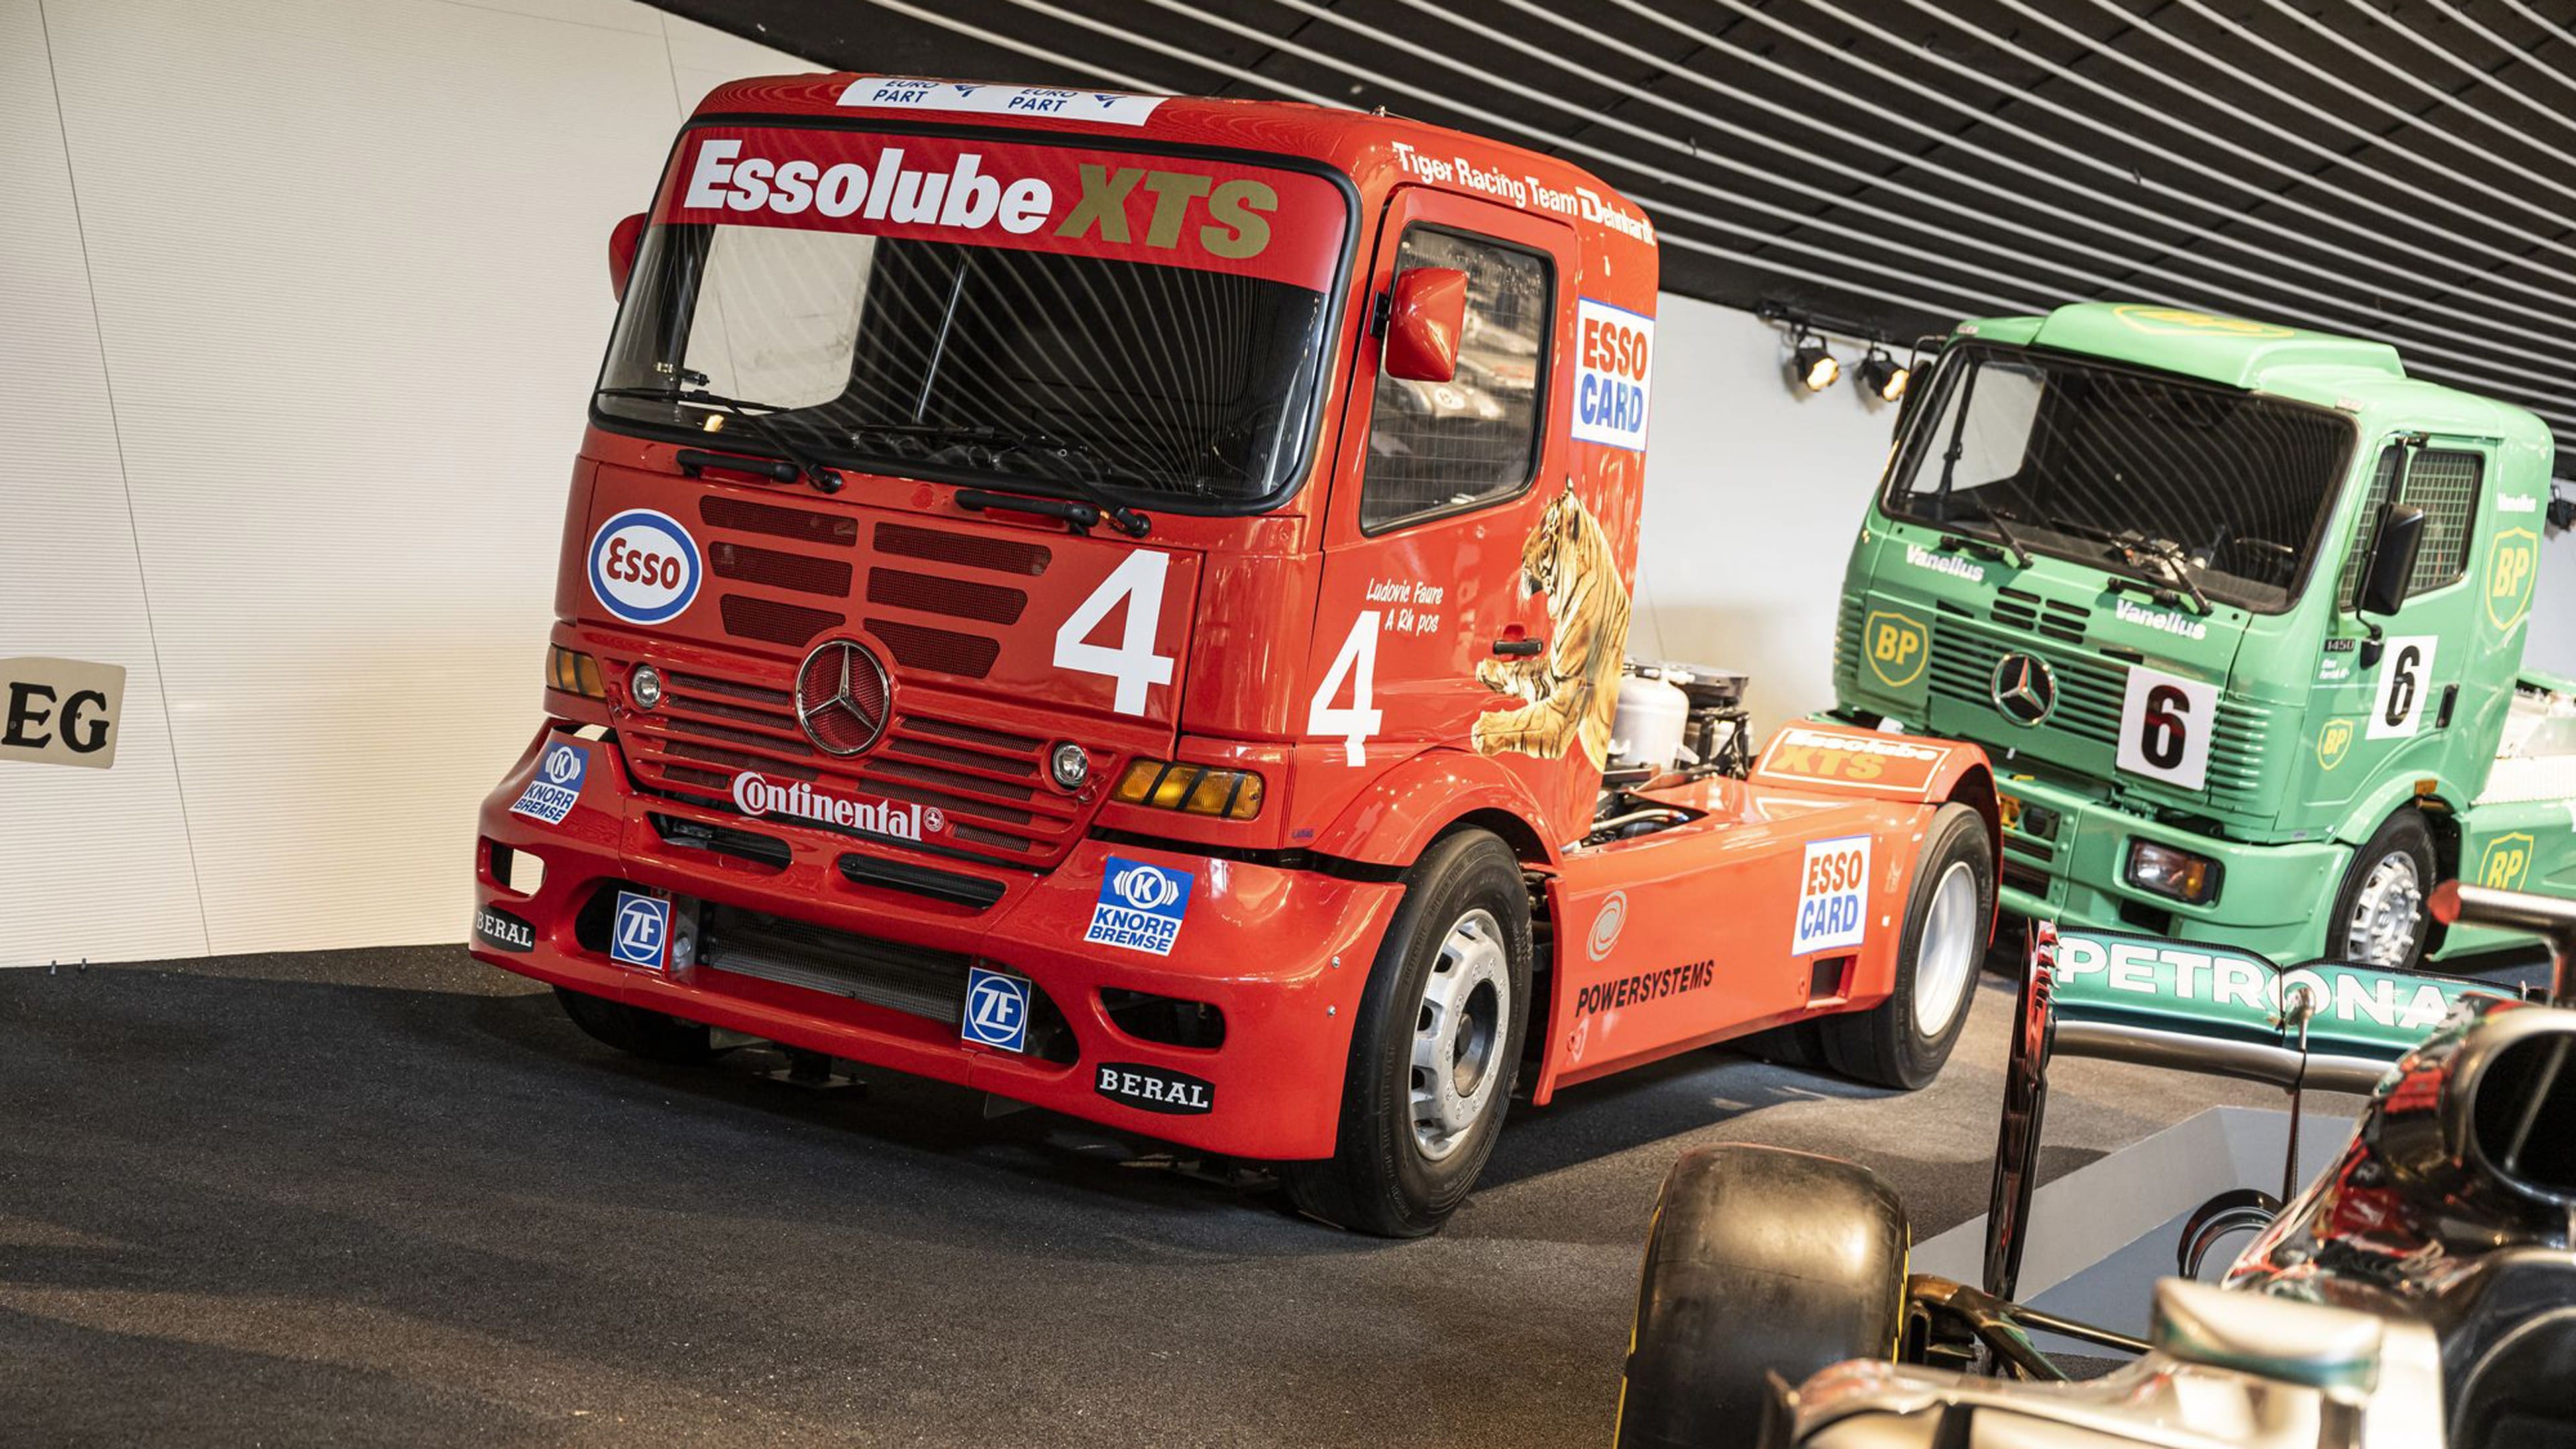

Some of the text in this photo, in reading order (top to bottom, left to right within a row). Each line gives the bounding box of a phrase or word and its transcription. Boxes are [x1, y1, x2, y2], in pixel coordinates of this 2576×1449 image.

[873, 89, 928, 103] PART
[1008, 97, 1067, 112] PART
[684, 139, 1279, 260] Essolube XTS
[1391, 141, 1453, 184] Tiger
[1454, 156, 1526, 209] Racing
[1525, 175, 1578, 216] Team
[1582, 318, 1648, 382] ESSO
[1580, 373, 1644, 434] CARD
[1906, 544, 1984, 582] Vanellus
[2492, 547, 2530, 597] BP
[1366, 578, 1443, 605] Ludovic Faure
[1053, 549, 1174, 717] 4
[1384, 608, 1440, 637] A Rh pos
[2116, 598, 2207, 641] Vanellus
[1875, 624, 1919, 665] BP
[2328, 640, 2354, 650] 1450
[1307, 610, 1383, 767] 4
[2385, 645, 2420, 727] 6
[1, 682, 110, 753] EG
[2141, 684, 2190, 769] 6
[1769, 746, 1886, 780] XTS
[1784, 731, 1938, 761] Essolube
[2322, 729, 2348, 755] BP
[555, 753, 570, 777] K
[514, 798, 566, 821] BREMSE
[524, 784, 576, 810] KNORR
[733, 771, 922, 841] Continental
[1133, 874, 1157, 902] K
[1807, 850, 1863, 896] ESSO
[476, 910, 532, 947] BERAL
[623, 908, 661, 951] ZF
[1095, 907, 1177, 938] KNORR
[1801, 894, 1859, 941] CARD
[1088, 926, 1171, 953] BREMSE
[1575, 959, 1715, 1018] POWERSYSTEMS
[2057, 936, 2451, 1029] PETRONA
[975, 986, 1022, 1032] ZF
[1099, 1069, 1208, 1109] BERAL
